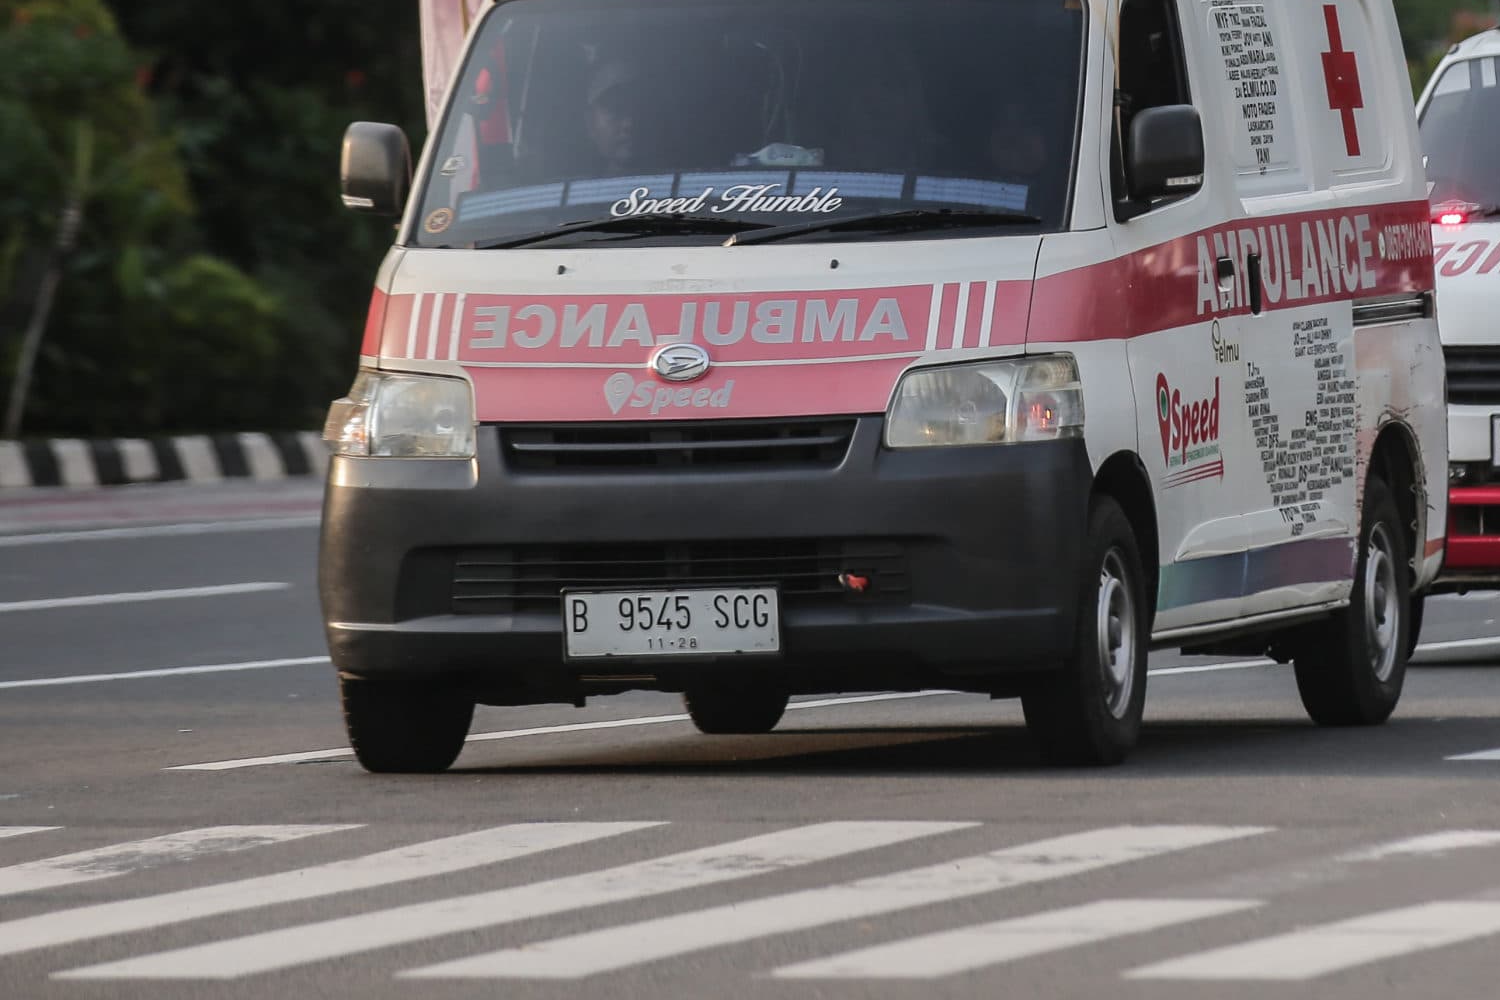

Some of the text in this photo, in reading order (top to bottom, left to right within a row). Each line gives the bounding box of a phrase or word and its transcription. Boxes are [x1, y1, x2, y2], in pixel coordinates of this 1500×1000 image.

[610, 183, 842, 217] Speed Humble
[630, 379, 735, 416] Speed
[1172, 376, 1220, 465] Speed
[572, 594, 769, 633] B 9545 SCG
